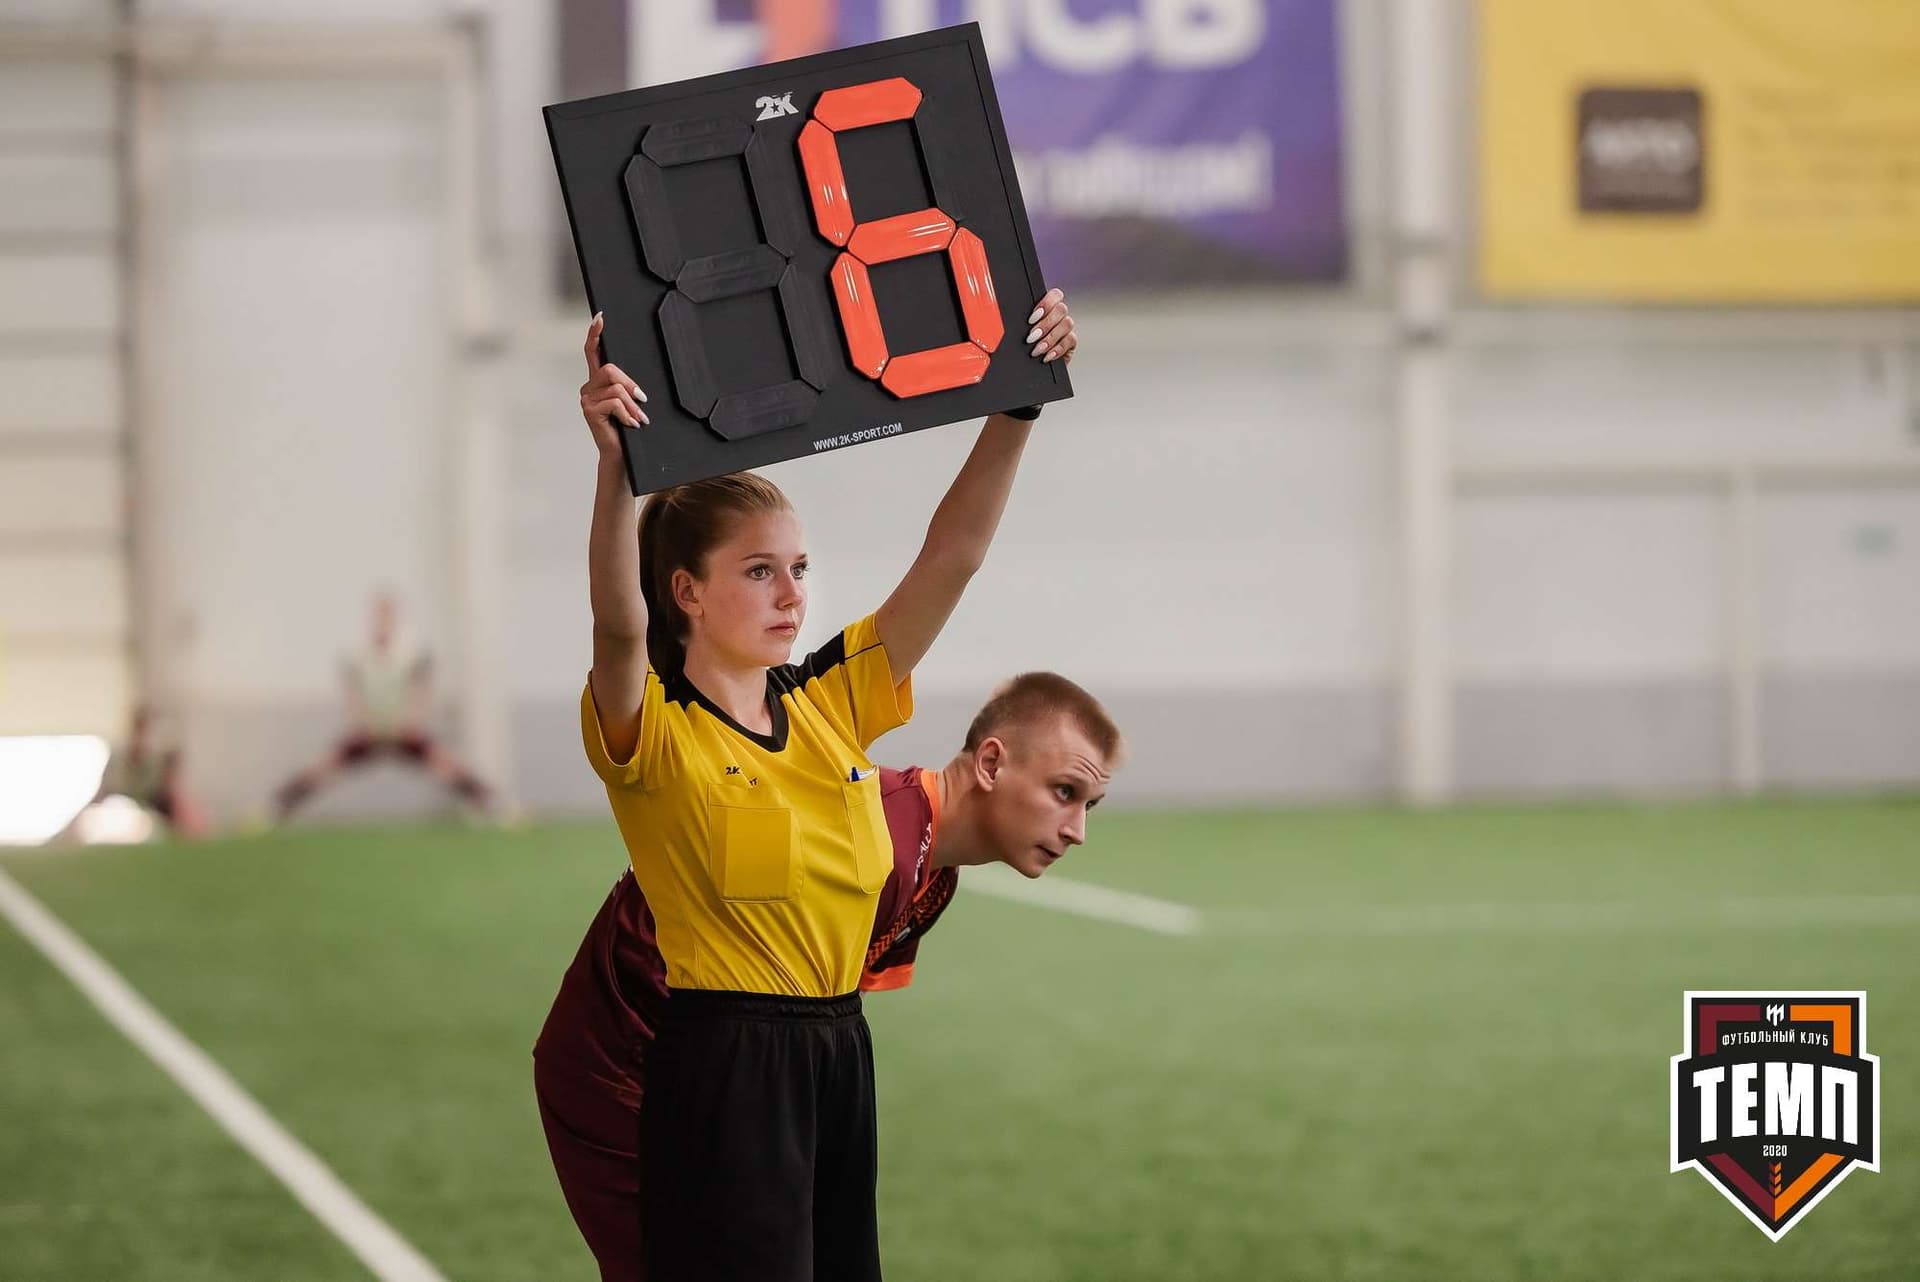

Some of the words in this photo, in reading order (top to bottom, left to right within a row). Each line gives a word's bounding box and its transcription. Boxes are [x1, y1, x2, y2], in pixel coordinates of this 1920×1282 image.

[755, 91, 800, 122] 2K
[798, 77, 1005, 399] 6
[813, 422, 903, 451] WWW.2K-SPORT.COM
